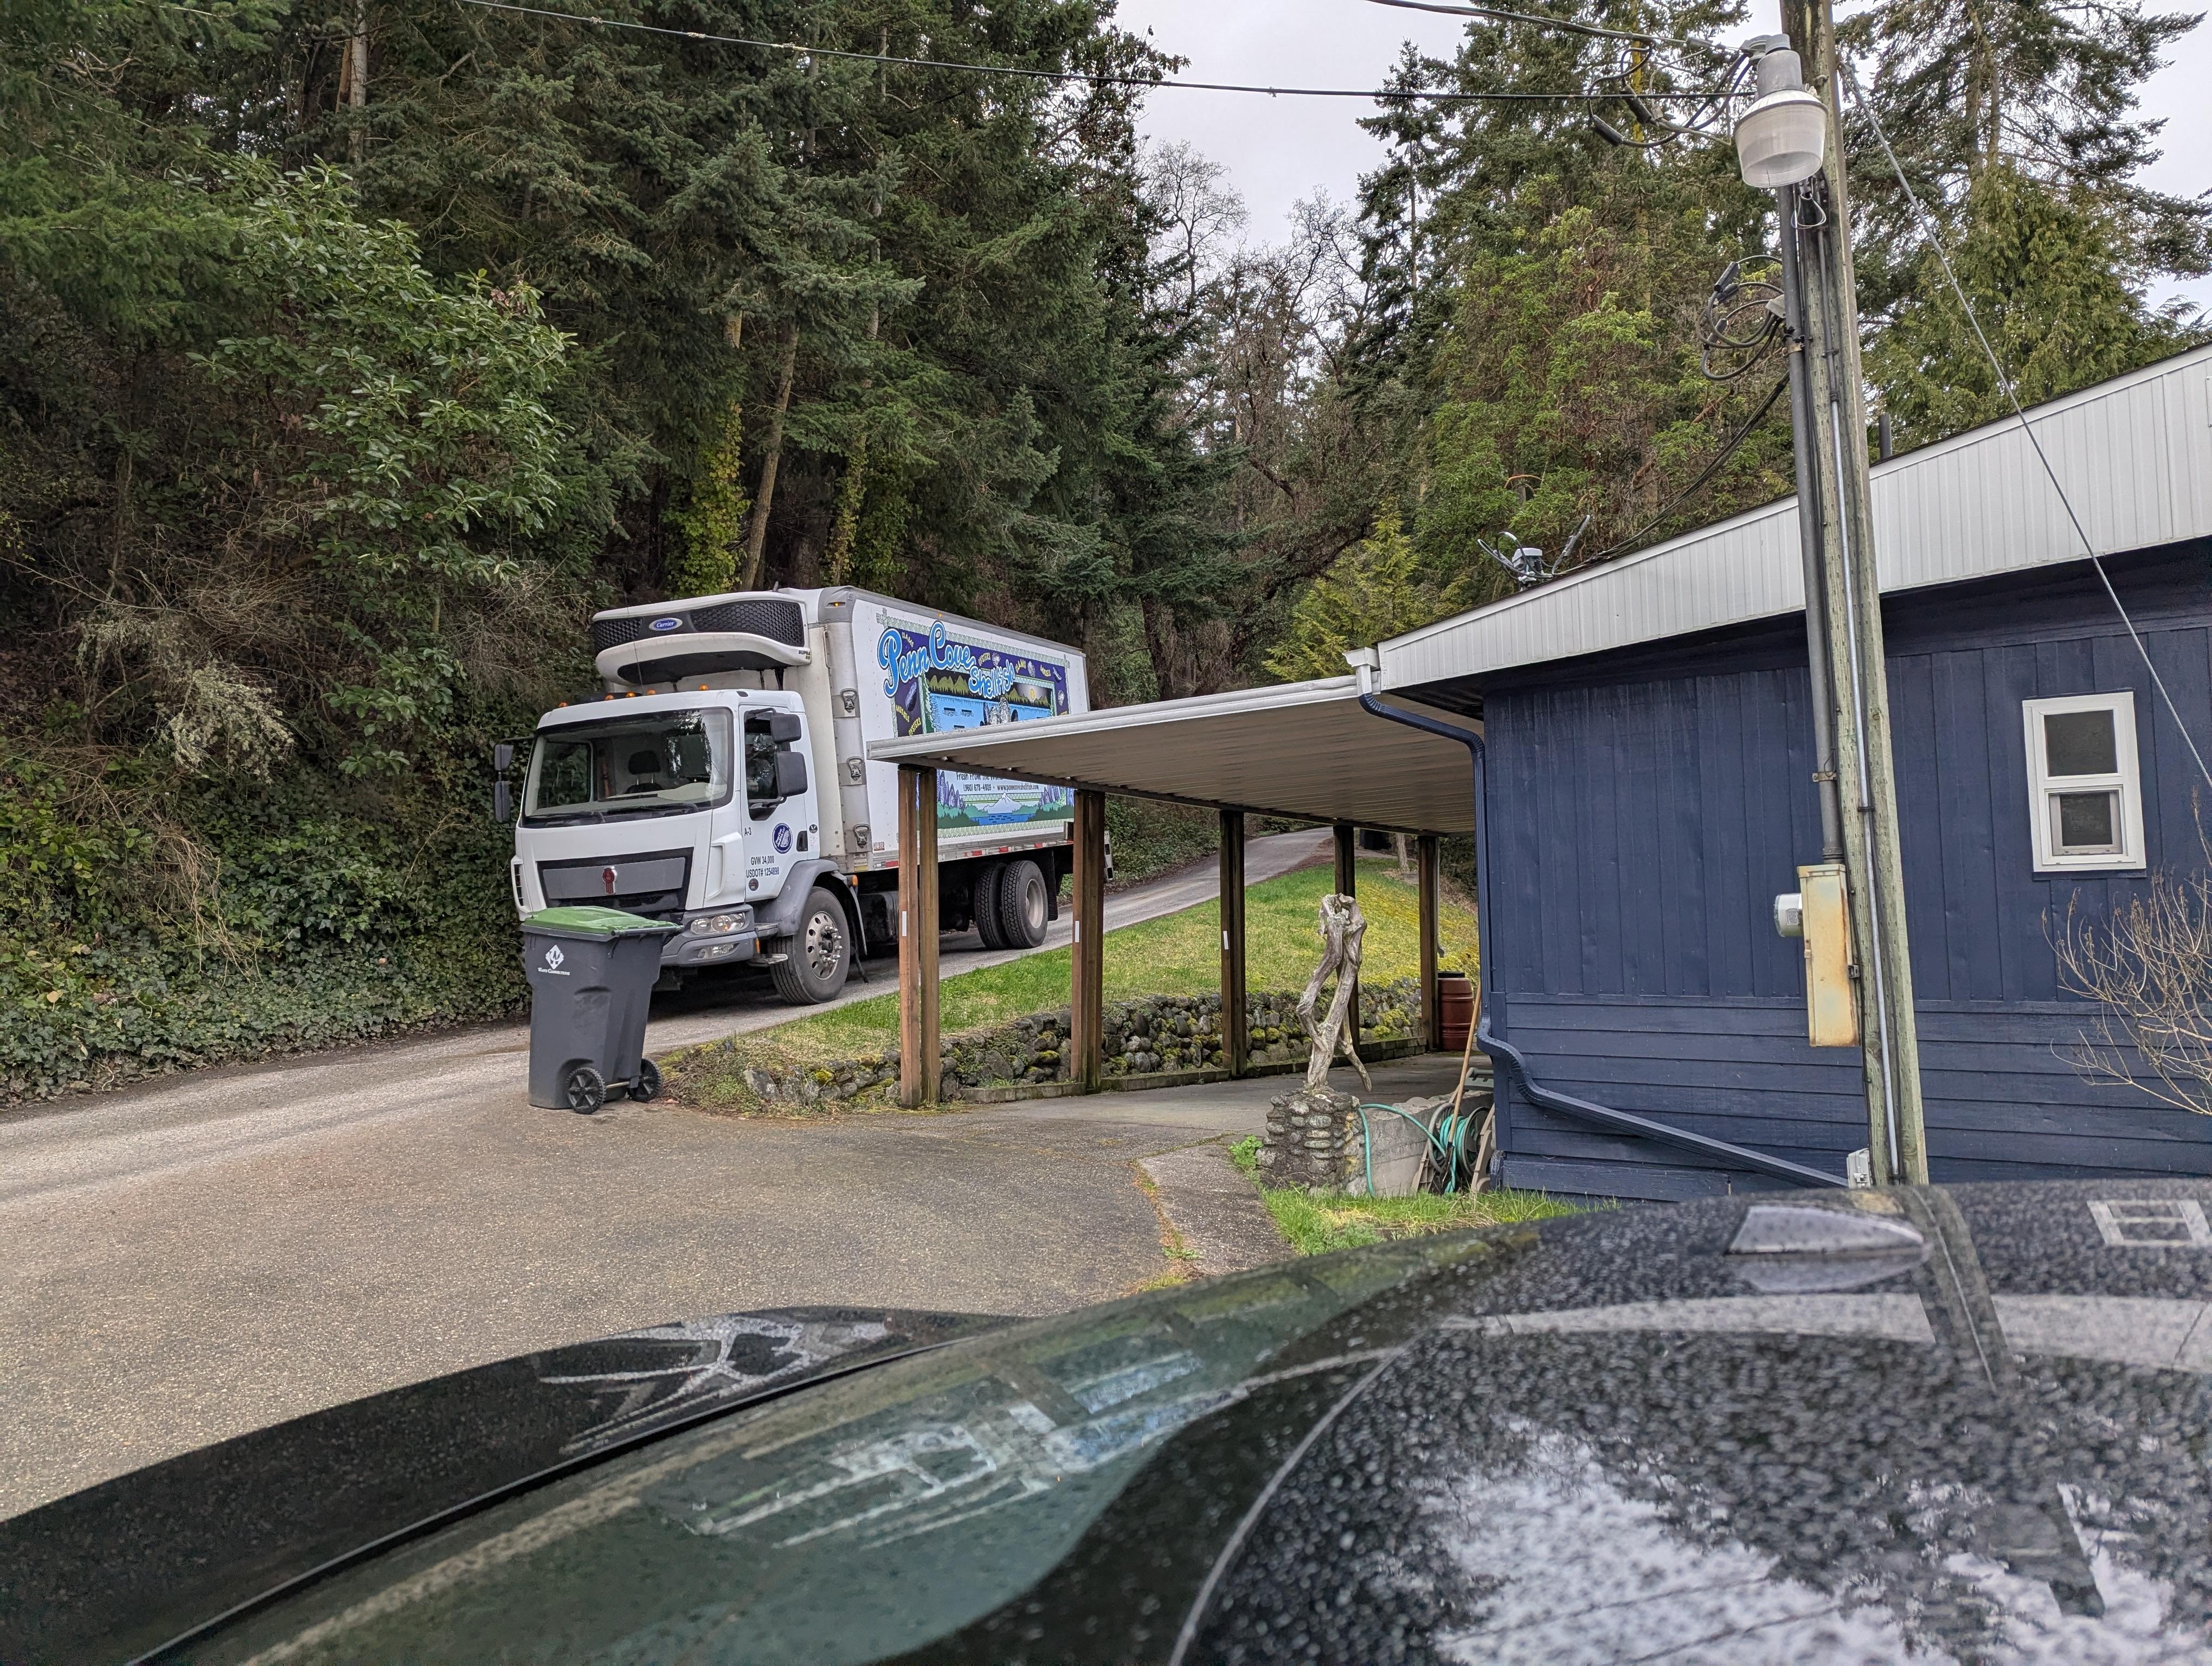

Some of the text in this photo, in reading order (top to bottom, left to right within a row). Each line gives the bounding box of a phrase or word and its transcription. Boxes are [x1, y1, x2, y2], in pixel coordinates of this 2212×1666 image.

[877, 620, 976, 699] Penn Cove
[978, 652, 991, 667] OYSTERS
[1015, 659, 1026, 673] CLAMS
[968, 659, 1015, 699] Shellfish
[908, 716, 922, 736] OYSTERS
[963, 784, 973, 792] (360)
[750, 855, 775, 866] GVW 34,000
[745, 868, 763, 878] USDOT#
